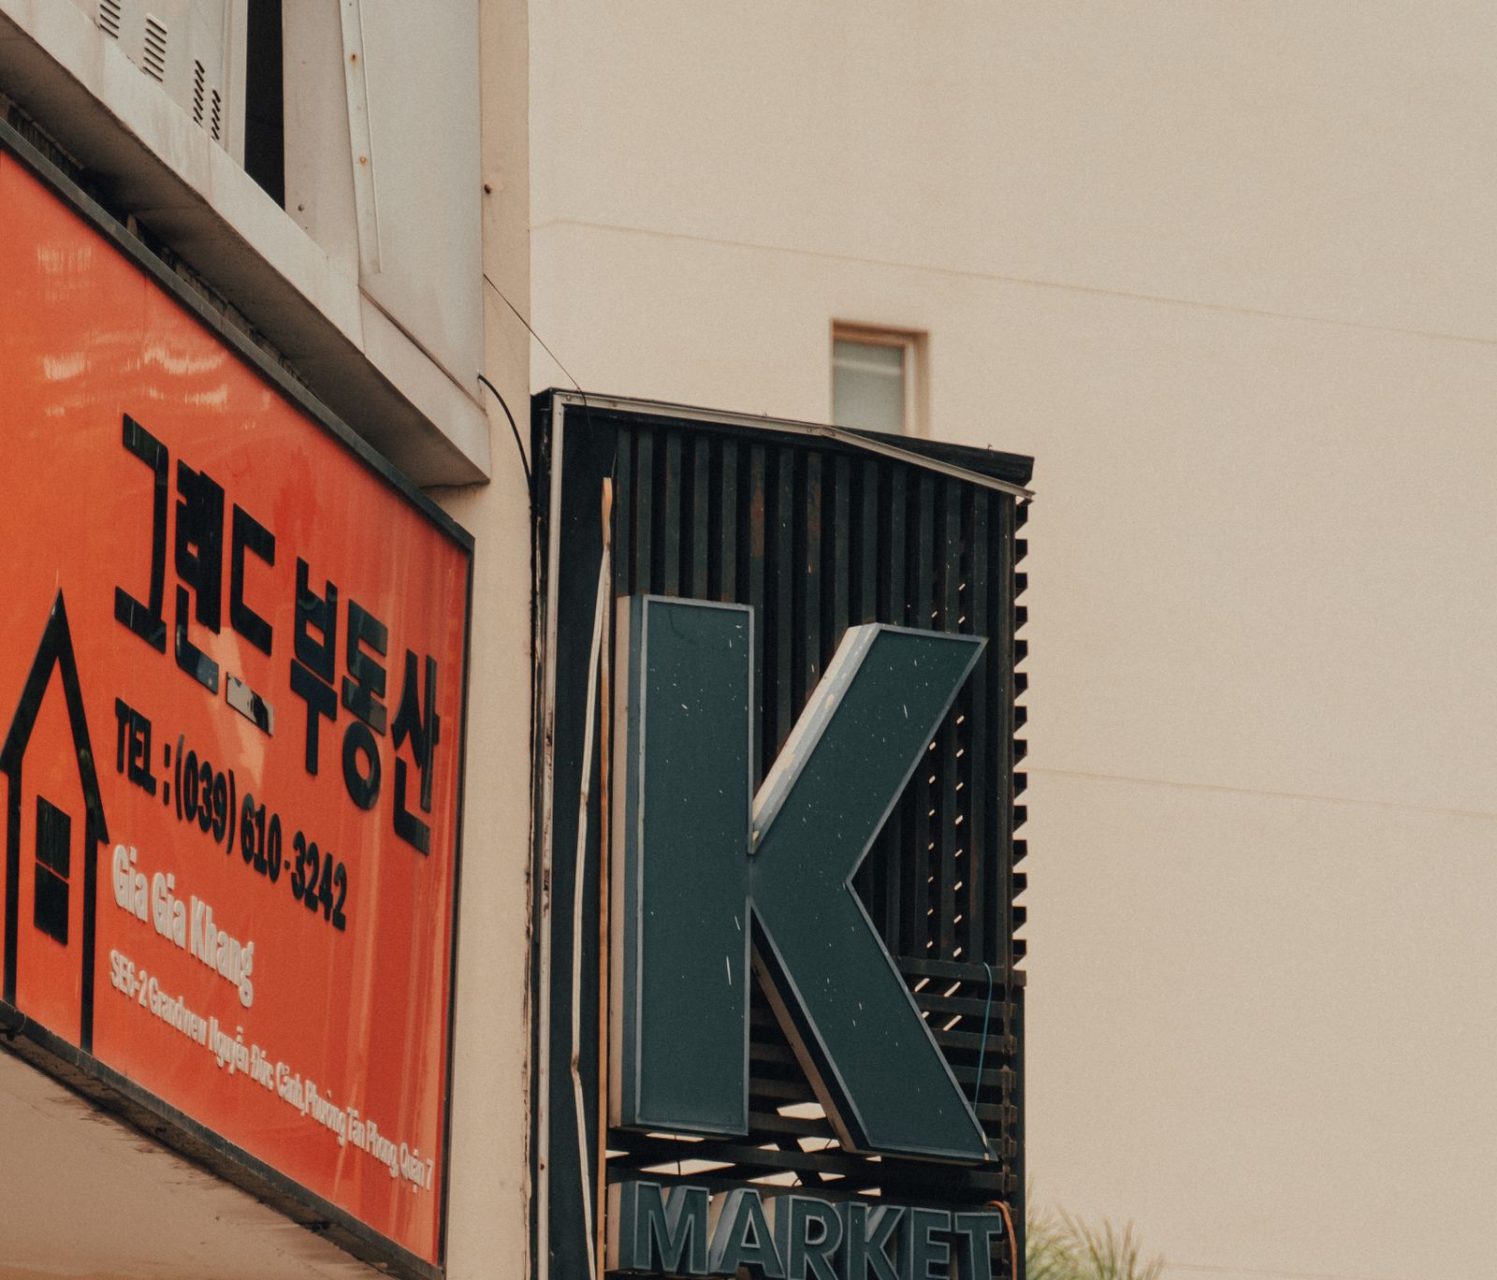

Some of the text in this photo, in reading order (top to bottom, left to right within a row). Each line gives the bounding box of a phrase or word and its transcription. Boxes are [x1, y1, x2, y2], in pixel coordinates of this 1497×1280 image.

[114, 412, 440, 856] 그랜드 부동산
[112, 844, 255, 1008] Gia Gia Khang
[149, 976, 207, 1046] Grandview
[612, 594, 998, 1164] K
